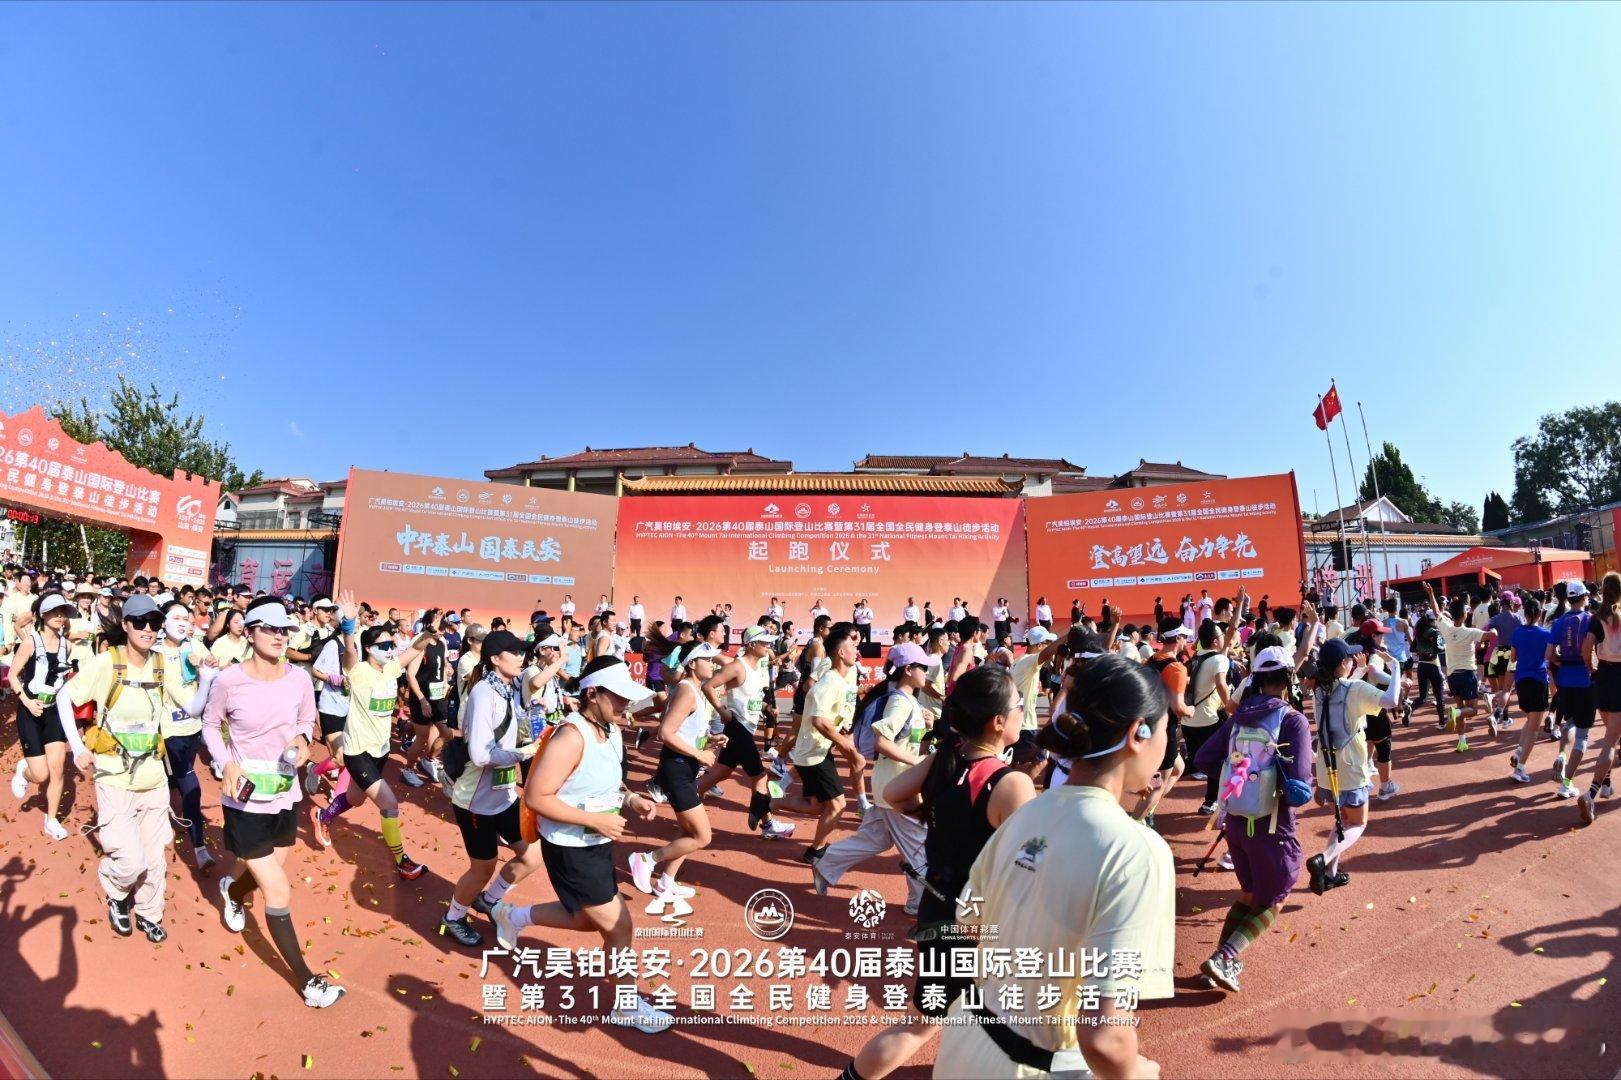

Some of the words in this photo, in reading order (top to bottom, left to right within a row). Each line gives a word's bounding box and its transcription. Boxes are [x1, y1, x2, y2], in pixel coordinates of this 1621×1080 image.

[396, 523, 475, 556] 中华泰山
[479, 535, 562, 563] 国泰民安
[748, 541, 891, 561] 起跑仪式
[1089, 537, 1169, 570] 登高望远
[1174, 531, 1258, 563] 奋力争先
[768, 564, 823, 575] Launching
[826, 564, 880, 575] Ceremony
